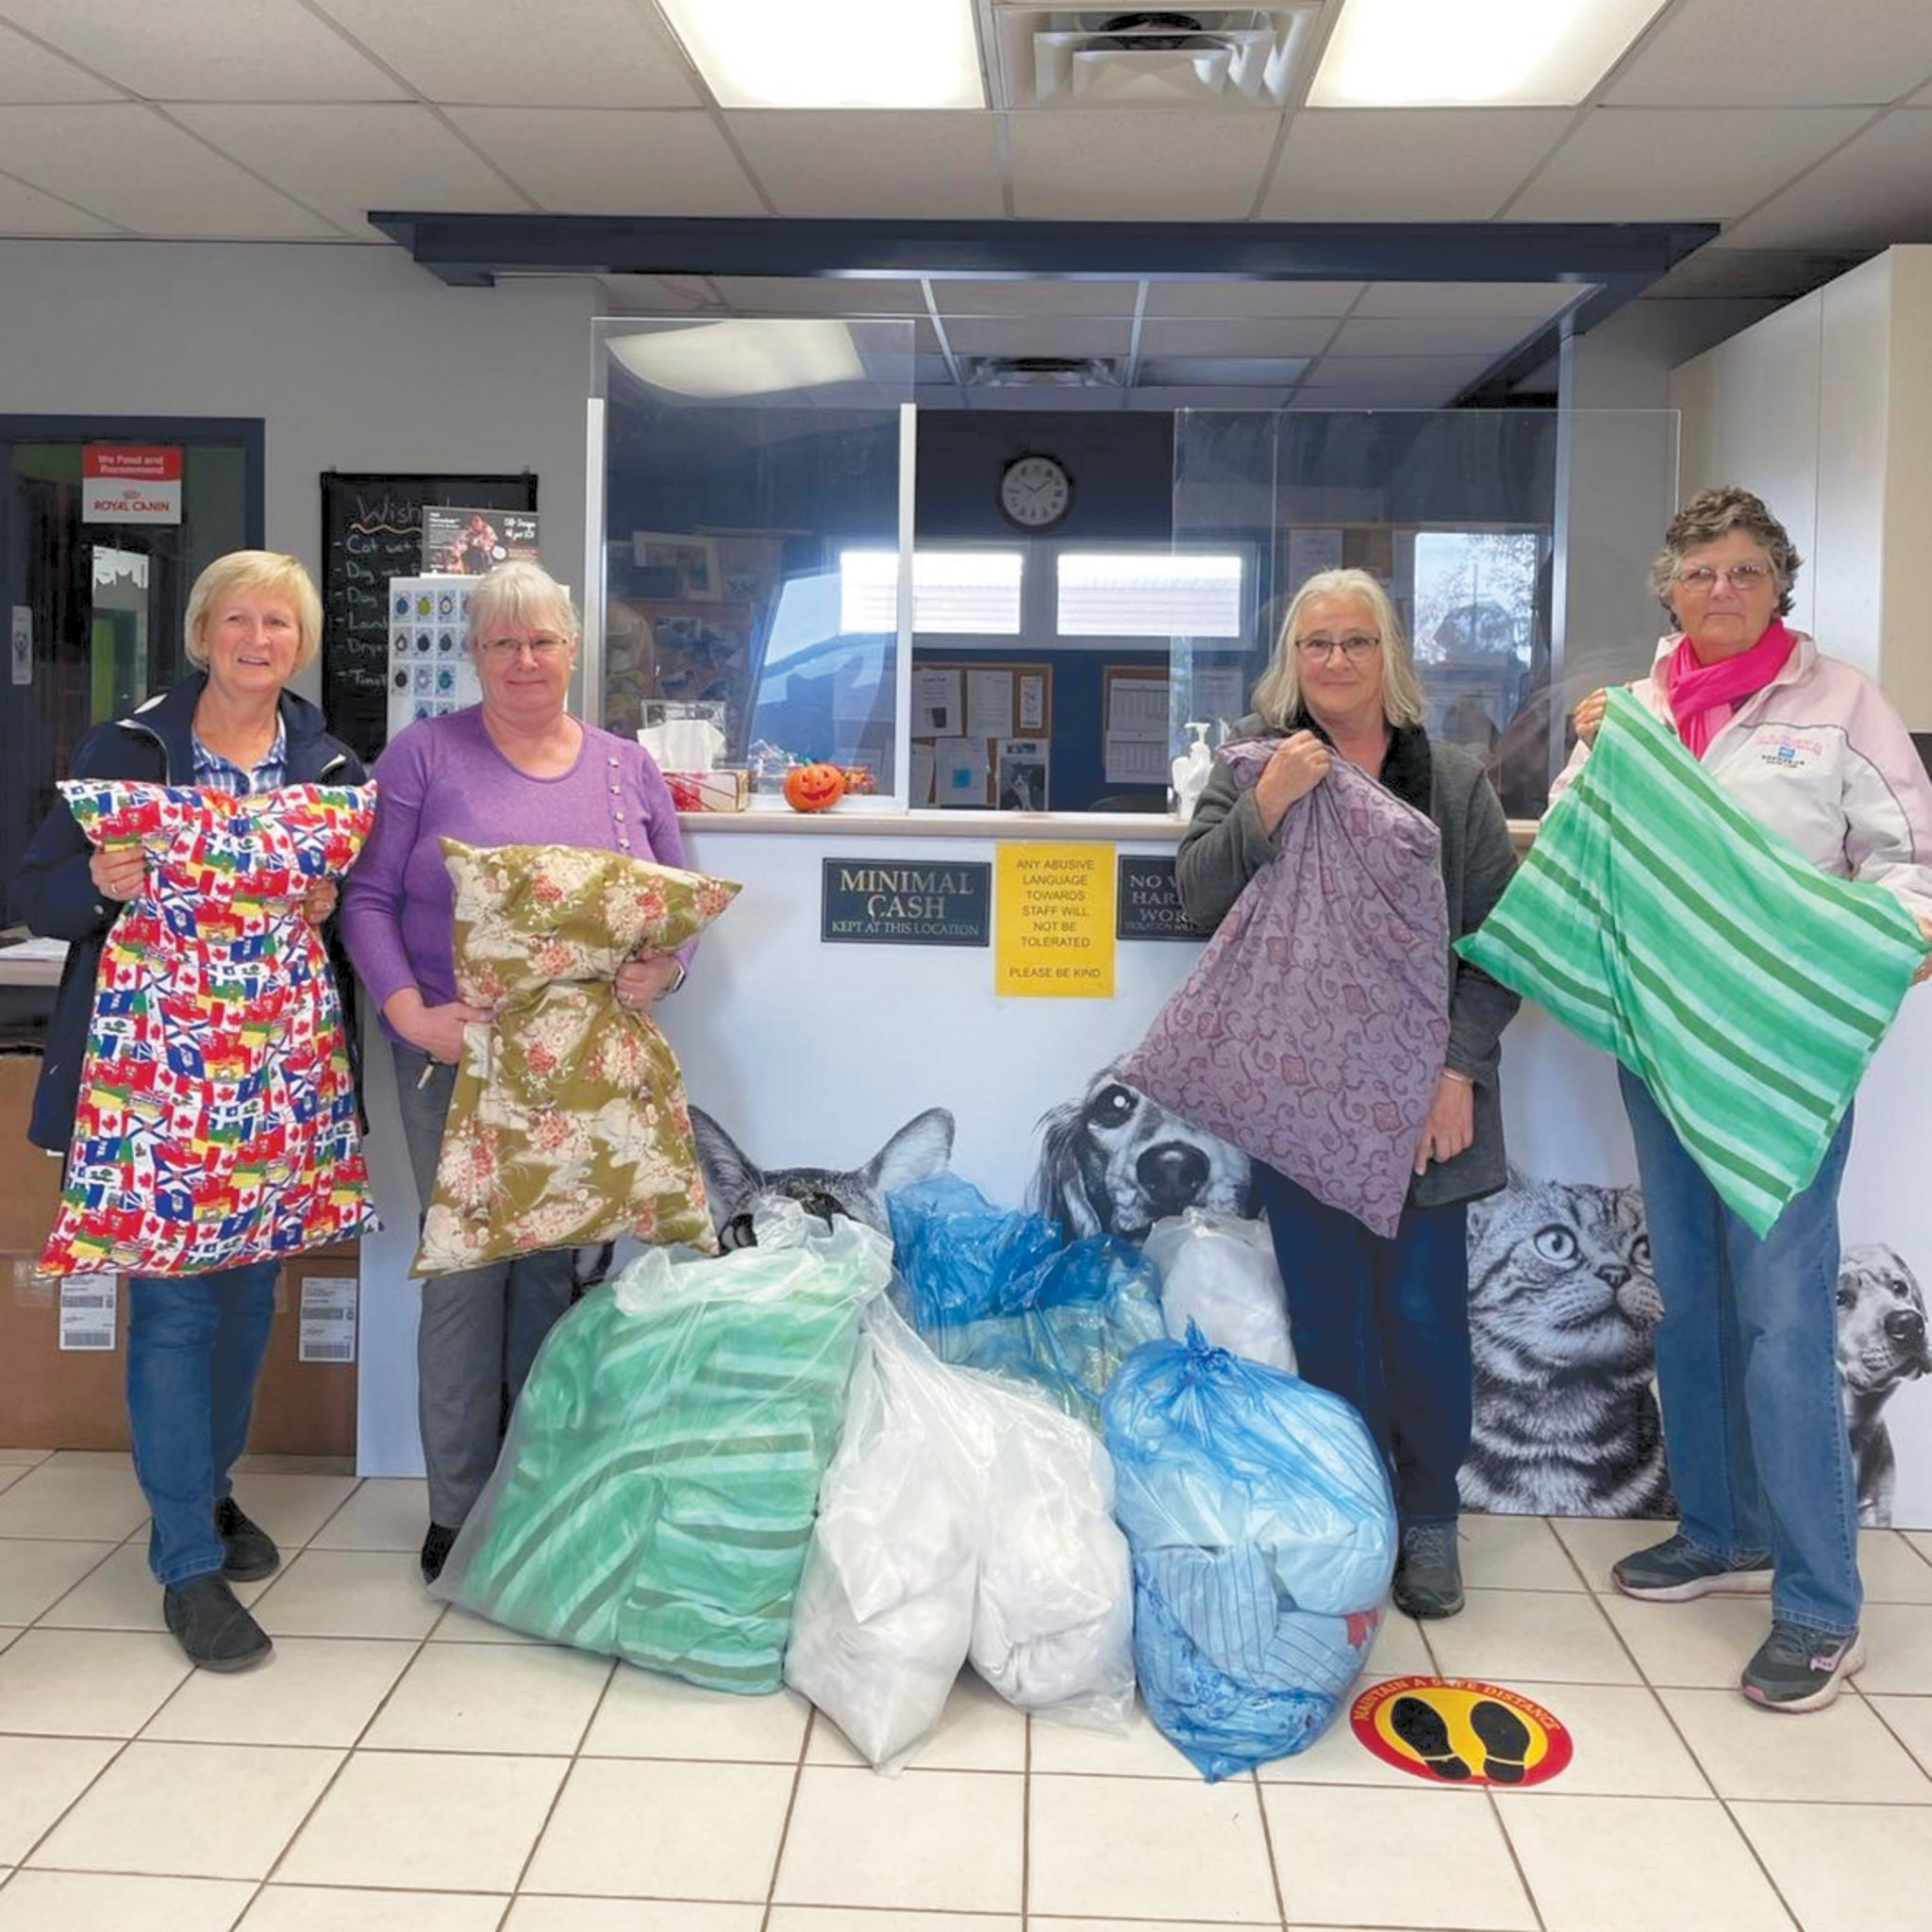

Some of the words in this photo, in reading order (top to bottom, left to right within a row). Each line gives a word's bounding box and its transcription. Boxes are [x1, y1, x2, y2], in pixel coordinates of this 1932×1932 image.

[94, 500, 129, 511] ROYAL
[132, 500, 170, 511] CANIN
[346, 534, 377, 555] Cat
[1017, 859, 1041, 870] ANY
[1044, 859, 1095, 870] ABUSIVE
[840, 869, 974, 895] MINIMAL
[1023, 874, 1089, 886] LANGUAGE
[1130, 874, 1161, 889] NO
[1026, 891, 1086, 901] TOWARDS
[1132, 891, 1177, 905] HAR
[867, 894, 946, 921] CASH
[1022, 906, 1058, 916] STAFF
[1060, 906, 1089, 916] WILL
[831, 921, 863, 933] KEPT
[864, 922, 880, 934] AT
[884, 922, 912, 935] THIS
[914, 924, 980, 937] LOCATION
[1033, 921, 1058, 932] NOT
[1061, 921, 1077, 932] BE
[1021, 936, 1091, 947] TOLERATED
[1009, 967, 1053, 978] PLEASE
[1056, 967, 1071, 978] BE
[1074, 968, 1101, 979] KIND
[1353, 1680, 1409, 1722] MAINTAIN
[1414, 1677, 1426, 1688] A
[1484, 1686, 1561, 1730] DISTANCE
